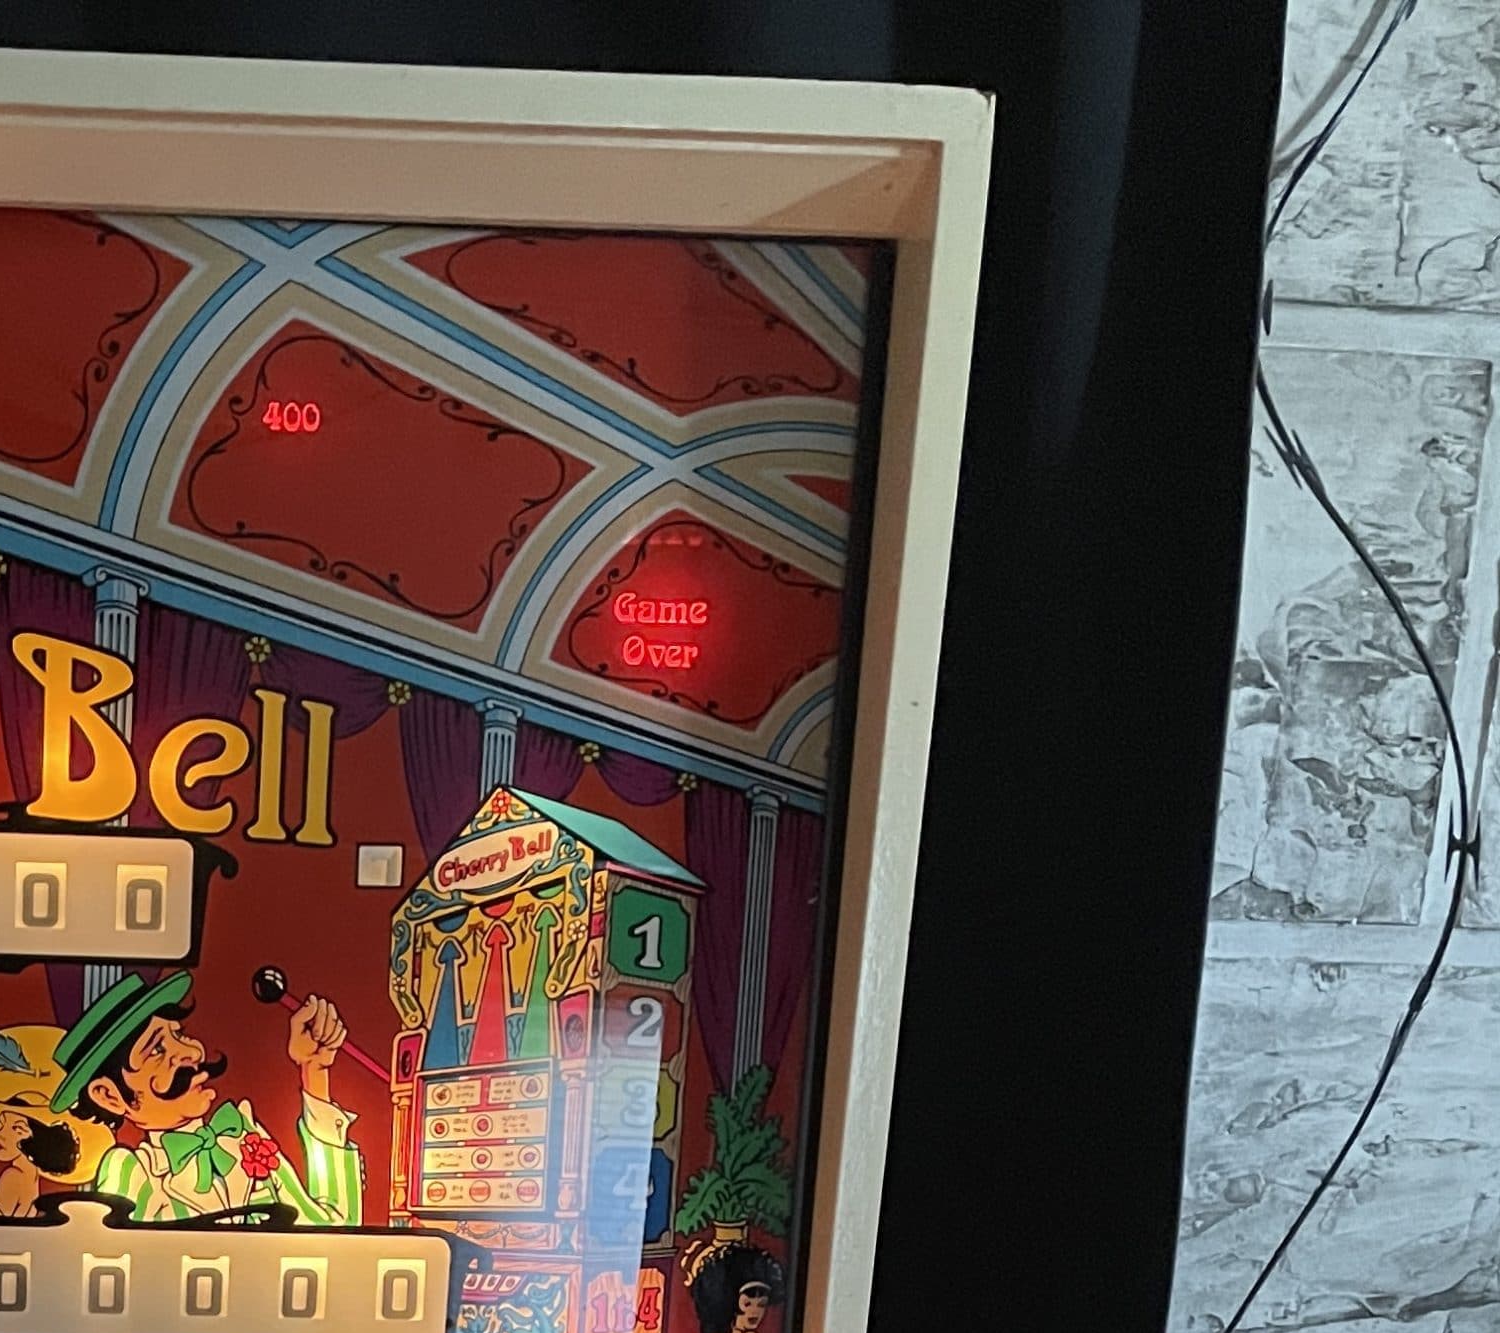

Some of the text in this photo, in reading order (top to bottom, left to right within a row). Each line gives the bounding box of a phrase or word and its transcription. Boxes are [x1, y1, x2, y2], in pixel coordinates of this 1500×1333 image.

[261, 399, 322, 434] 400
[613, 591, 708, 626] Game
[621, 636, 699, 670] Over
[10, 630, 337, 846] Bell
[437, 829, 553, 887] Cherry Bell
[631, 915, 664, 970] 1
[626, 996, 664, 1049] 2
